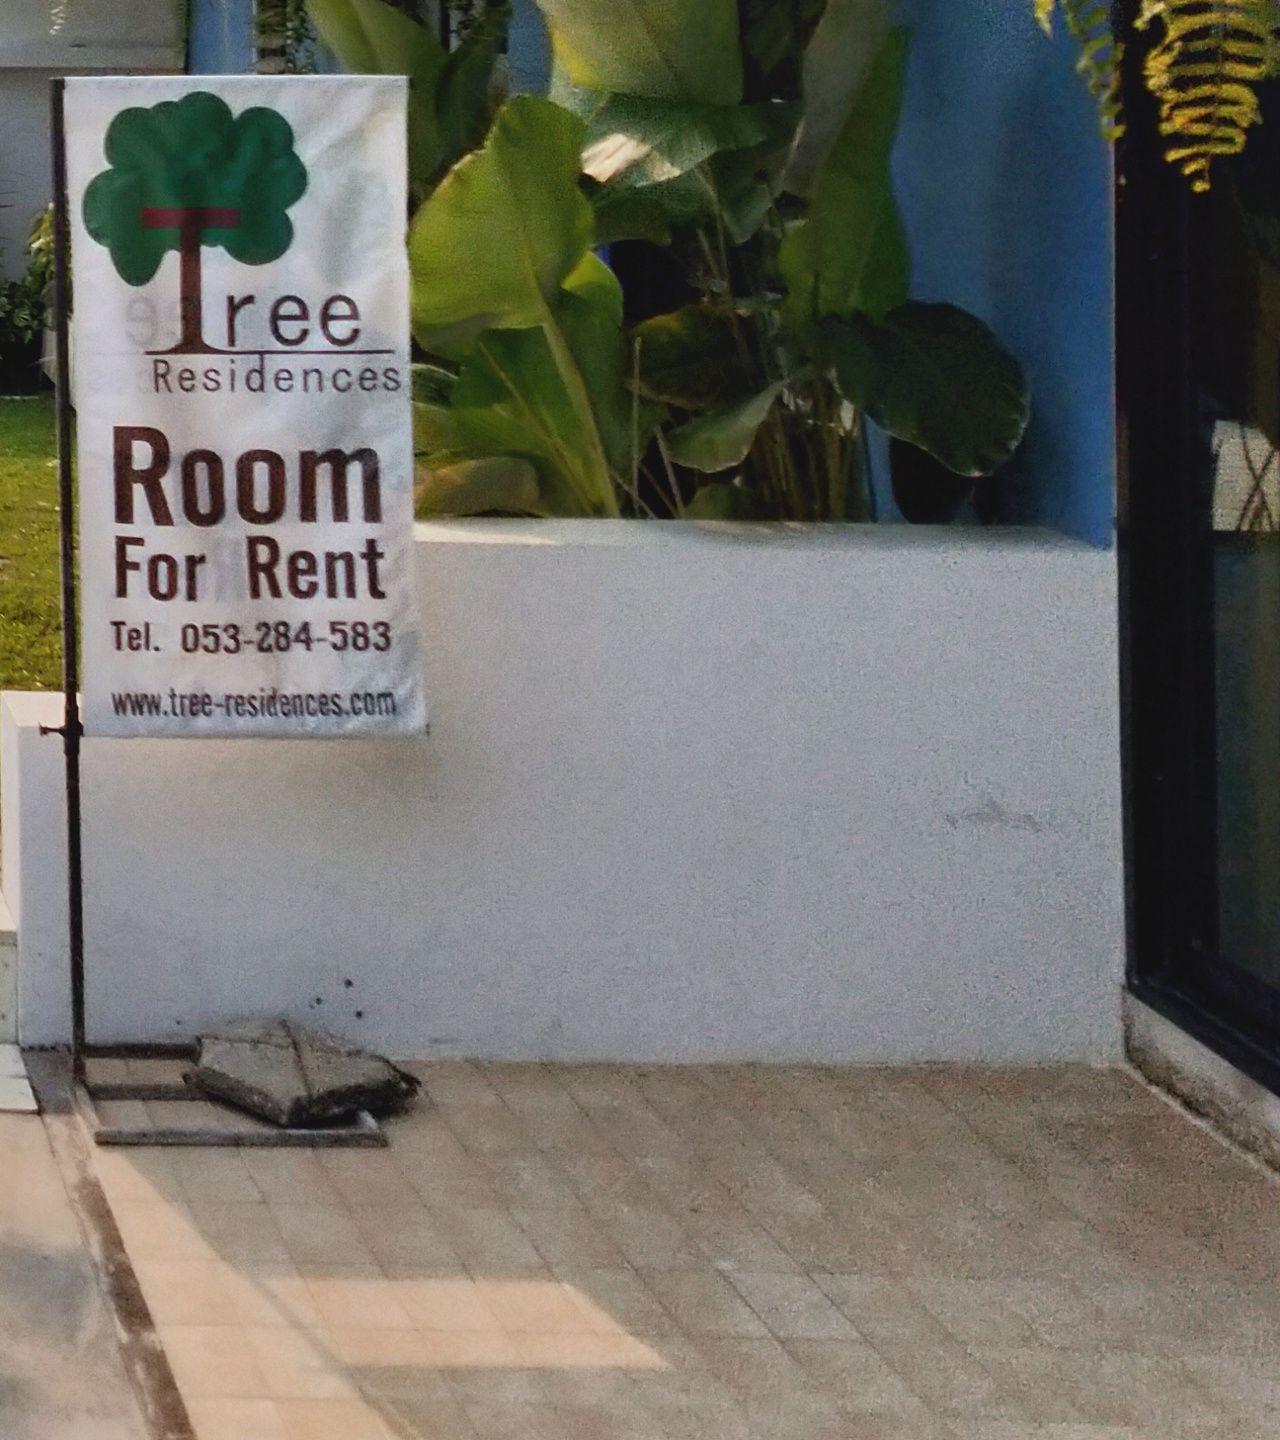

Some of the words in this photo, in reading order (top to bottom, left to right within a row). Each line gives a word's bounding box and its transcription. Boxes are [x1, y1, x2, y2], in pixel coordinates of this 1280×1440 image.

[153, 354, 402, 393] Residences
[113, 426, 382, 527] Room
[115, 535, 207, 602] For
[246, 535, 387, 600] Rent
[110, 621, 161, 652] Tel.
[181, 621, 391, 654] 053-284-583
[110, 686, 397, 718] www.tree-residences.com
